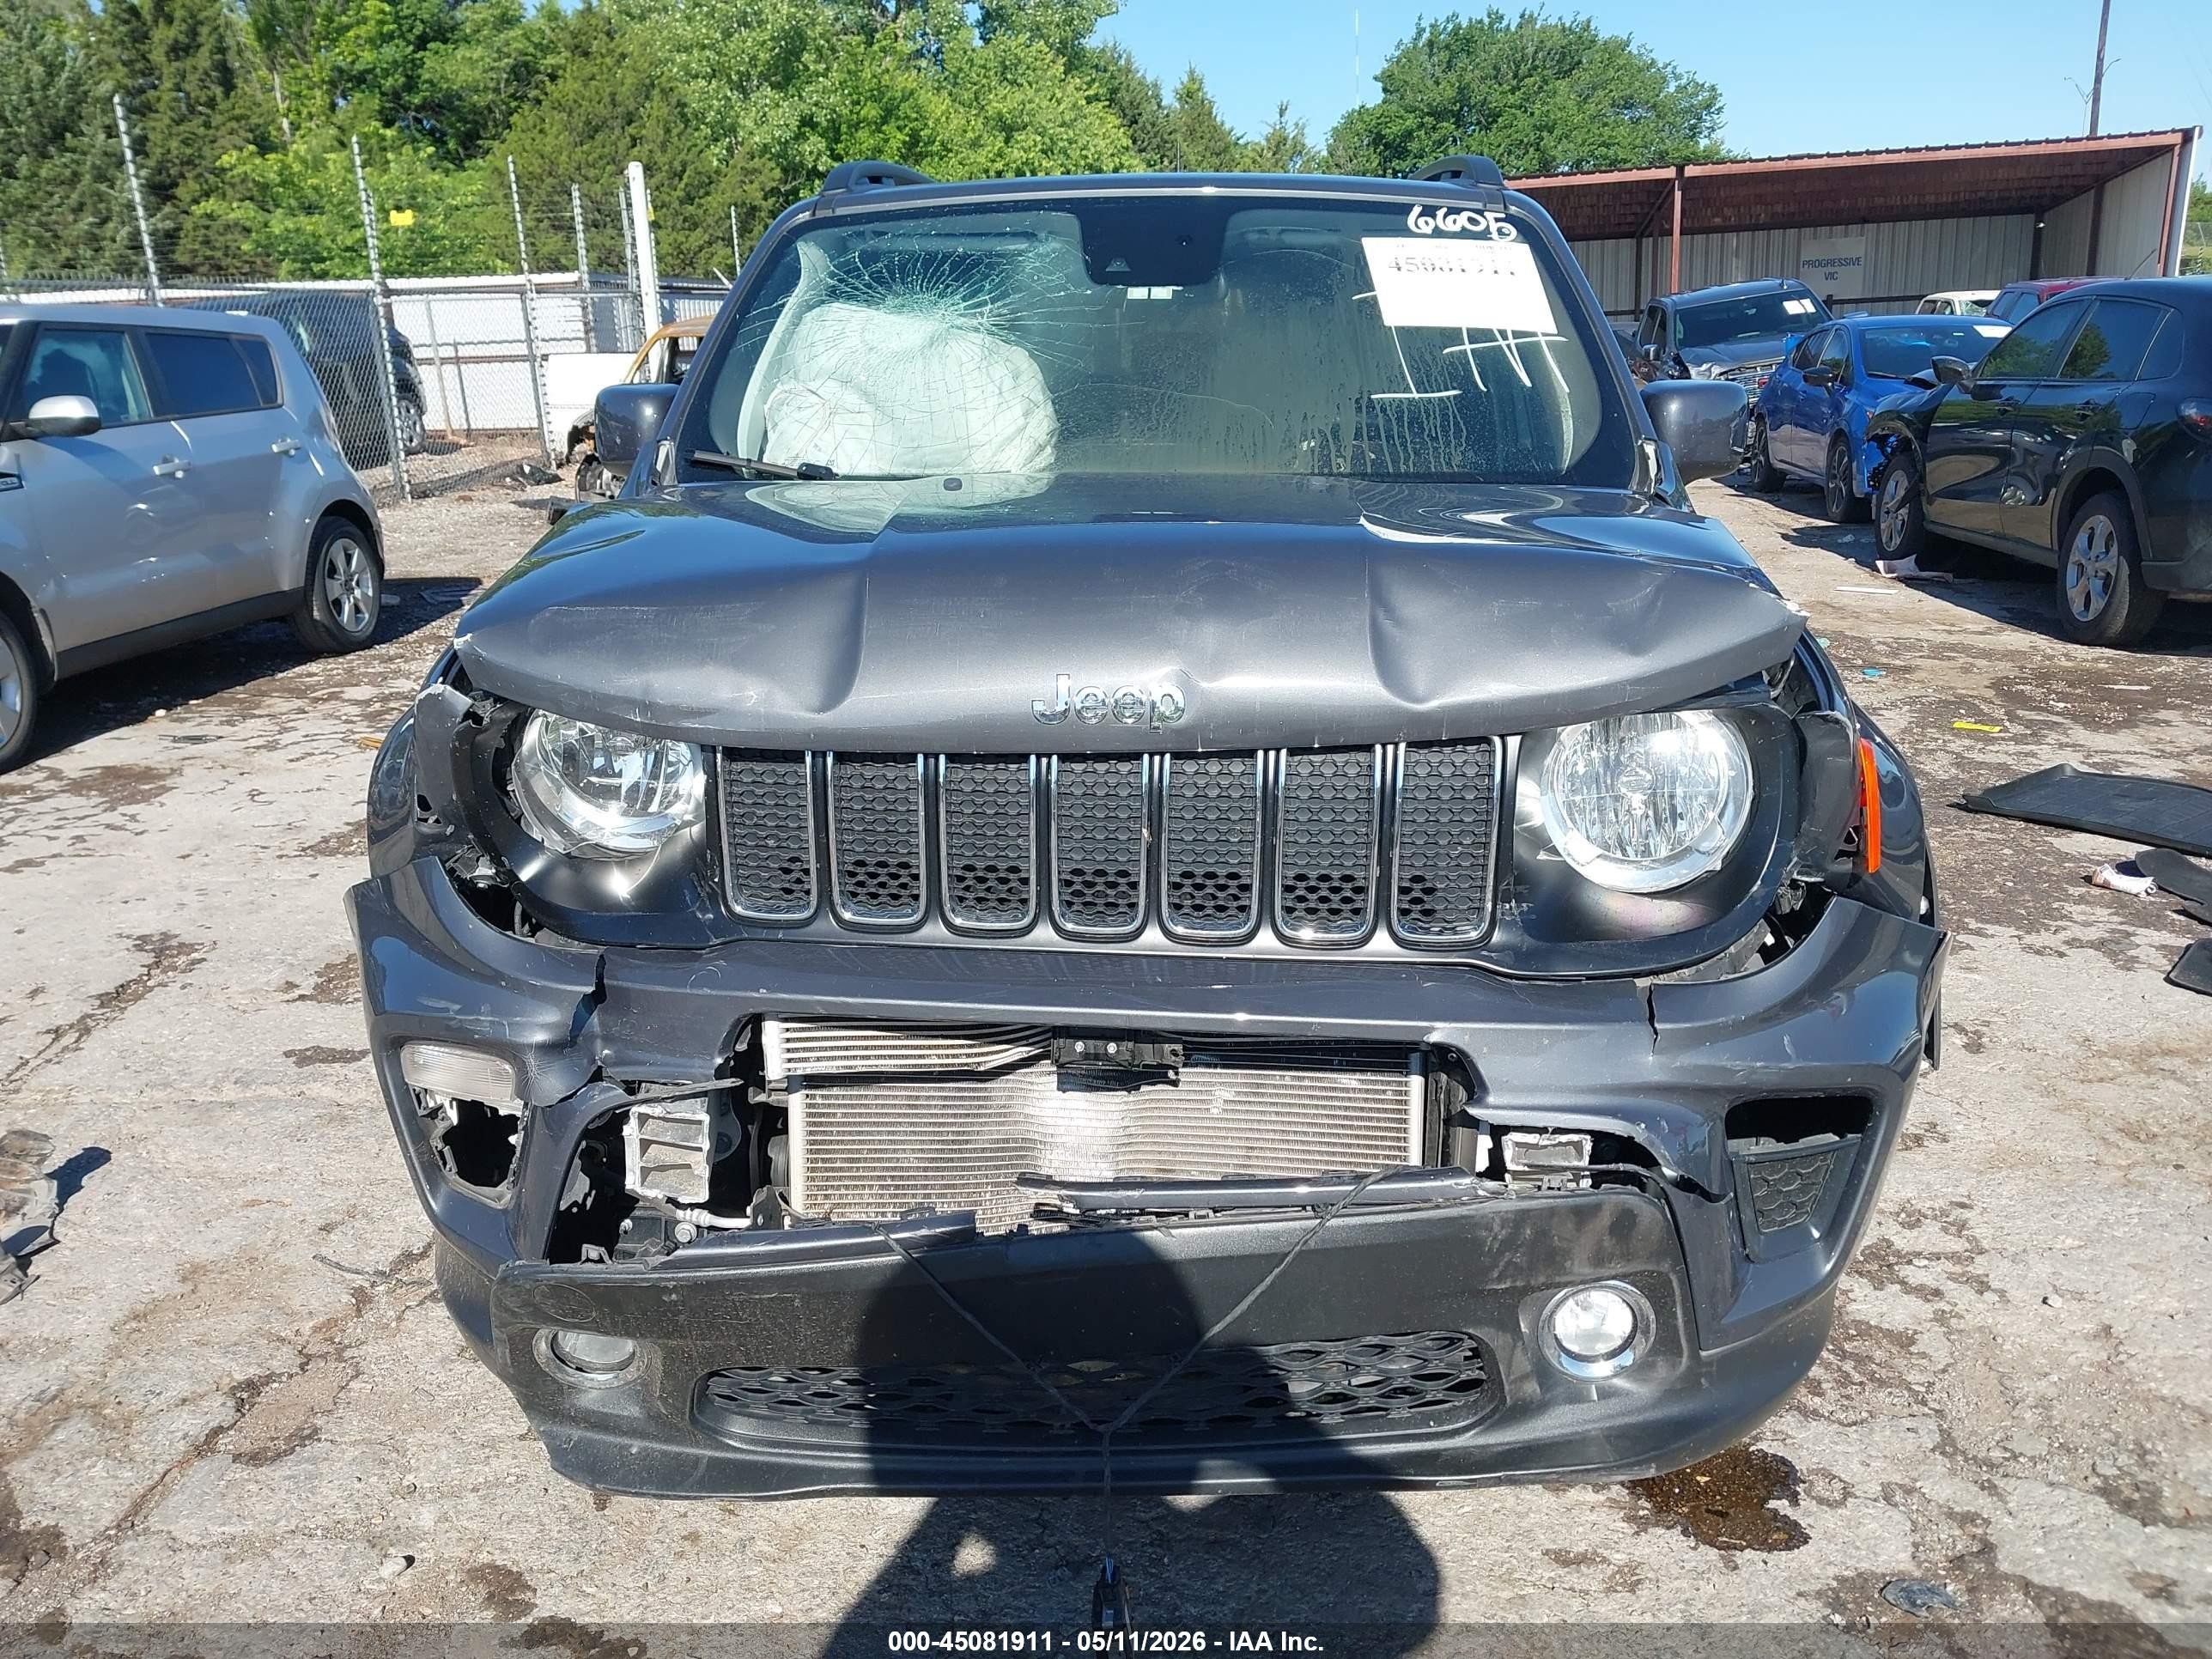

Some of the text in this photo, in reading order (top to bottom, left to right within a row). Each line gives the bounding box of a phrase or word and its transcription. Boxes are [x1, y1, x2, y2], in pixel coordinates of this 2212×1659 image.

[1802, 257, 1862, 269] PROGRESSIVE
[1824, 271, 1838, 281] VIC
[1031, 673, 1186, 733] Jeep
